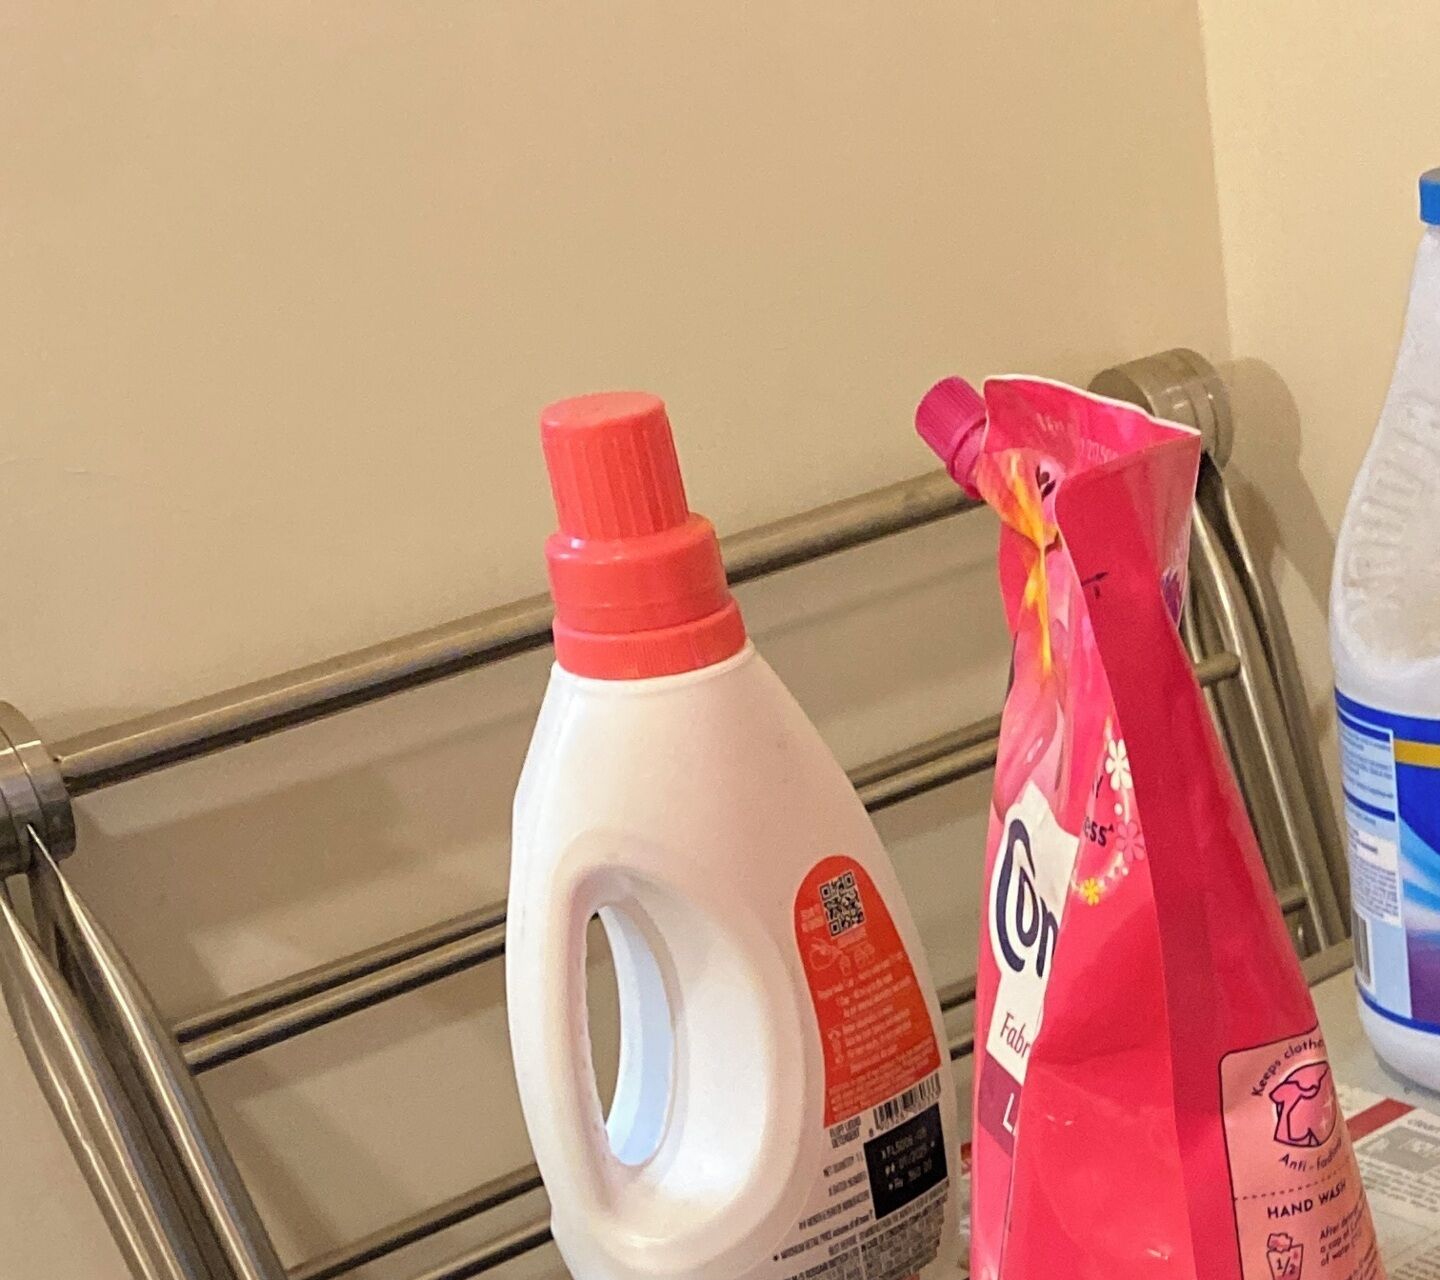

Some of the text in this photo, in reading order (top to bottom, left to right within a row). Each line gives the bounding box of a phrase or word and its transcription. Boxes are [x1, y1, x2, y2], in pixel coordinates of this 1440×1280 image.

[1252, 1060, 1281, 1097] Keeps
[1267, 1178, 1347, 1219] HAND WASH
